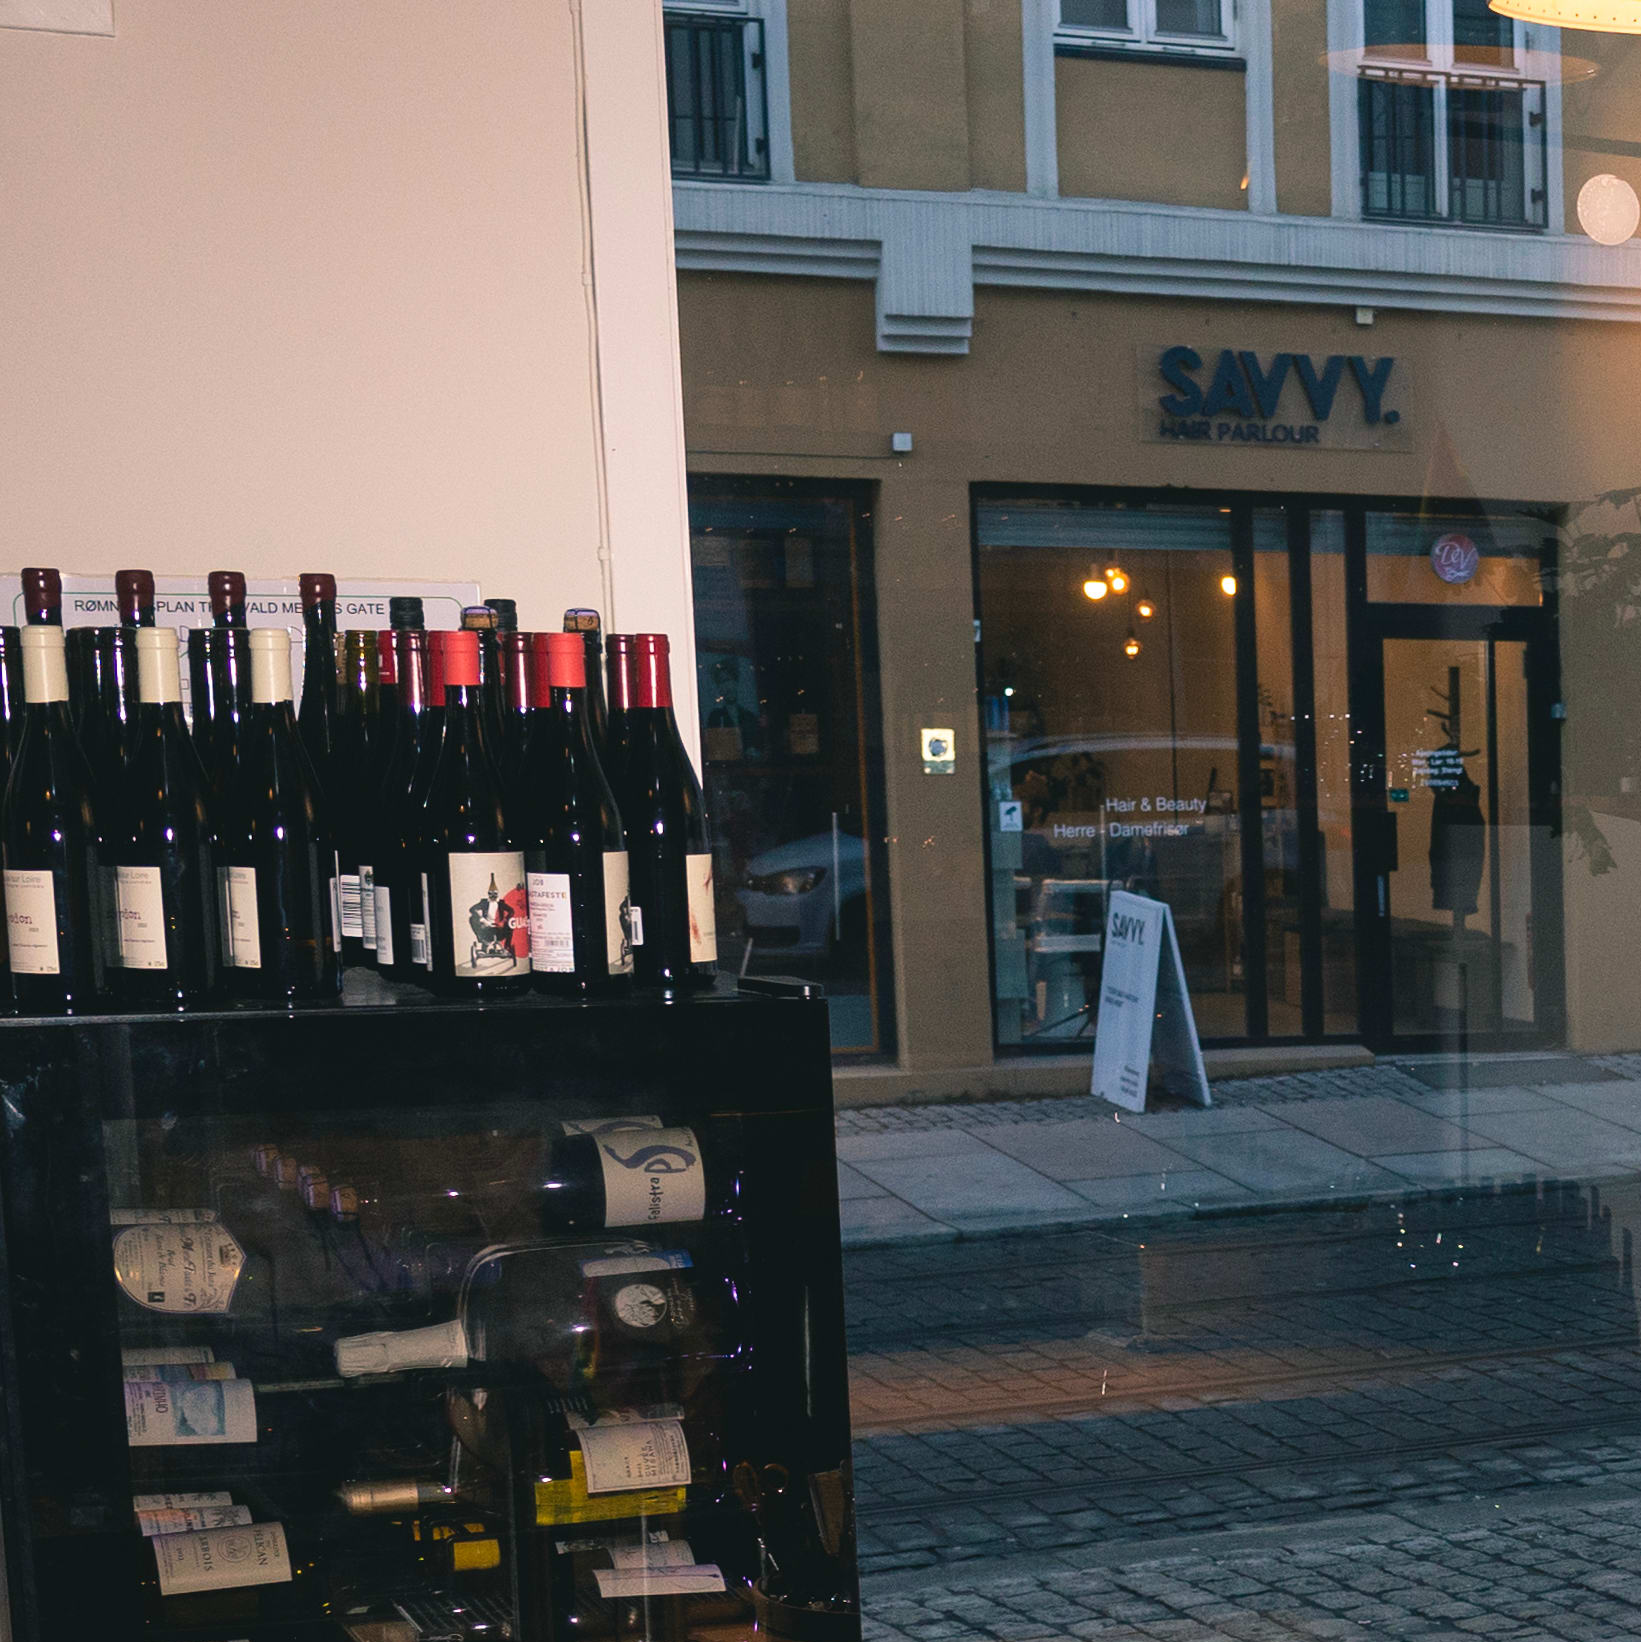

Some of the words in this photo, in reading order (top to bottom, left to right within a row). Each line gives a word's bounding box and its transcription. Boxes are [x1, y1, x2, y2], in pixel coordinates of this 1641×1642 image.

[1159, 345, 1400, 425] SAVVY.
[1159, 420, 1212, 440] HAIR
[1217, 422, 1320, 443] PARLOUR
[346, 603, 385, 615] GATE
[1105, 797, 1137, 812] Hair
[1140, 797, 1152, 812] &
[1155, 796, 1208, 814] Beauty
[1053, 823, 1095, 838] Herre
[198, 1536, 213, 1573] ARBOIS
